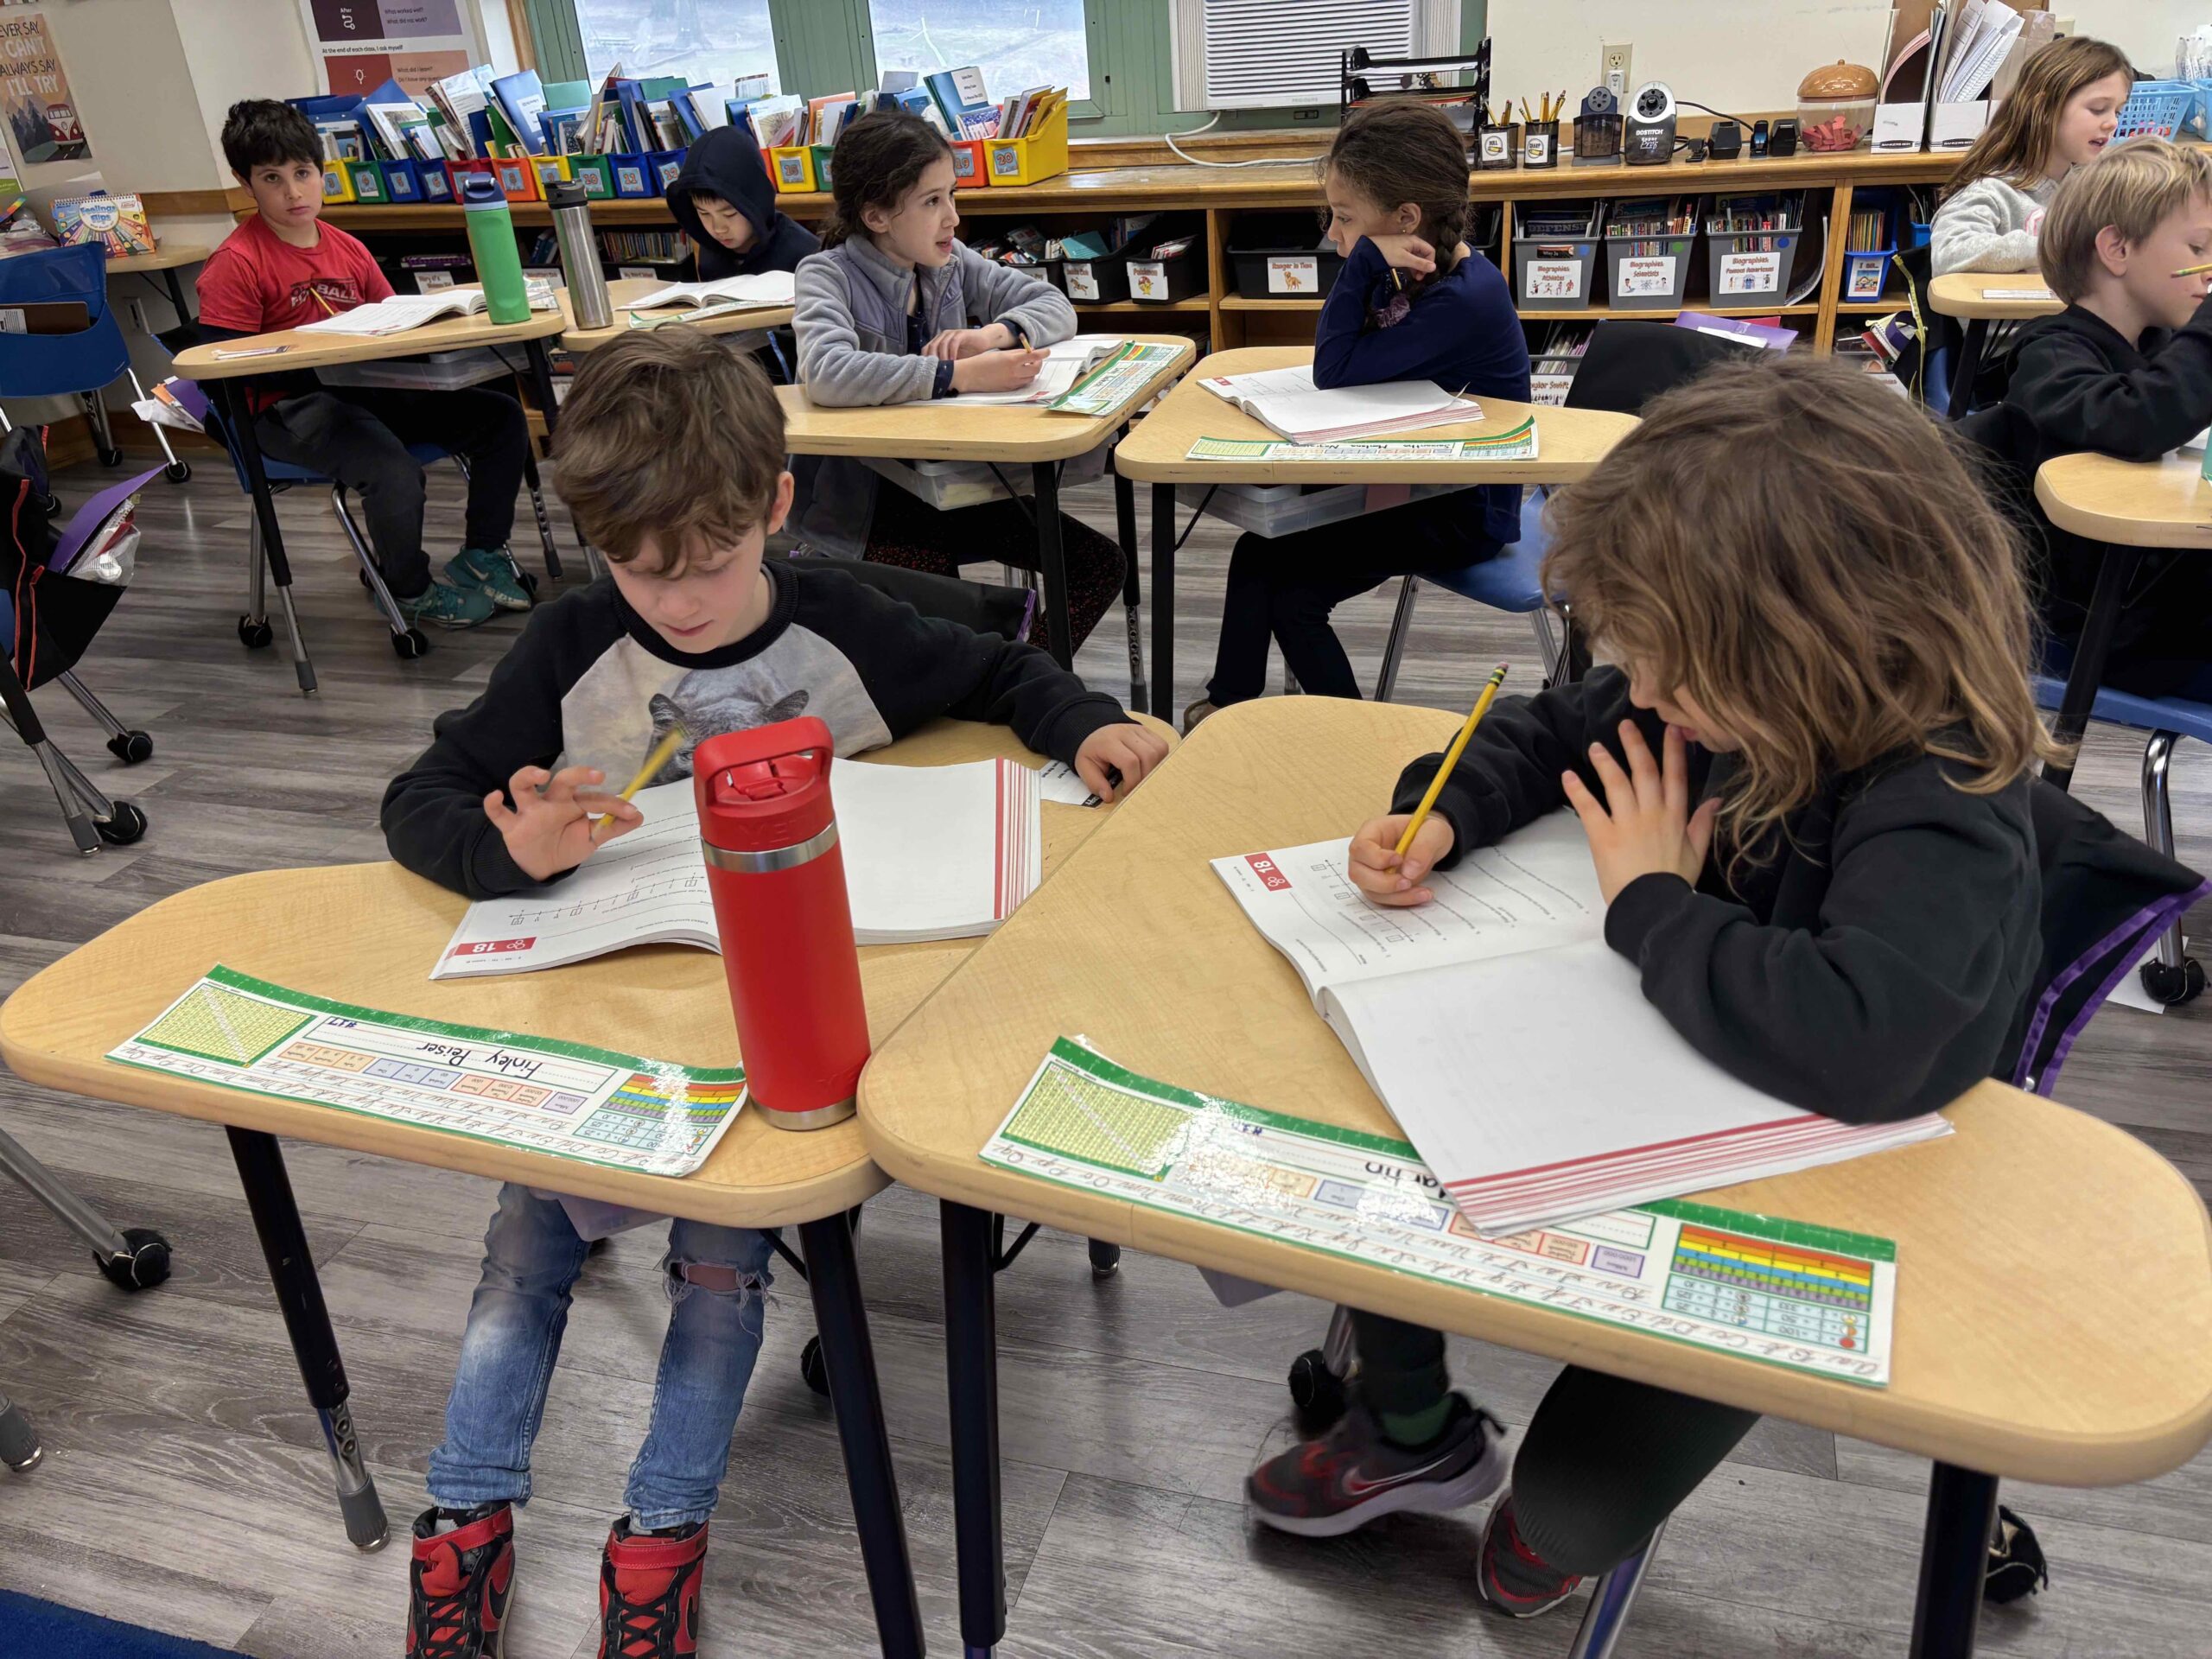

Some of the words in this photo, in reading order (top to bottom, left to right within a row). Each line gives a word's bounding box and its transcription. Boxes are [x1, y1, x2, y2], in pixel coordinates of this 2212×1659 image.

[22, 21, 40, 35] SAY
[5, 36, 47, 59] CAN'T
[0, 60, 38, 77] ALWAYS
[39, 59, 56, 73] SAY
[7, 76, 33, 97] I'LL
[34, 74, 59, 93] TRY
[956, 156, 970, 169] 19
[996, 151, 1014, 166] 20
[582, 173, 599, 185] 10
[79, 205, 117, 214] Feelings
[1531, 381, 1548, 391] aylor
[1549, 380, 1569, 390] Swift
[1254, 860, 1274, 874] 18
[471, 942, 496, 954] 18
[327, 1016, 358, 1029] #17
[416, 1041, 472, 1066] Peiser
[485, 1049, 543, 1079] Finley
[1365, 1160, 1446, 1198] artin
